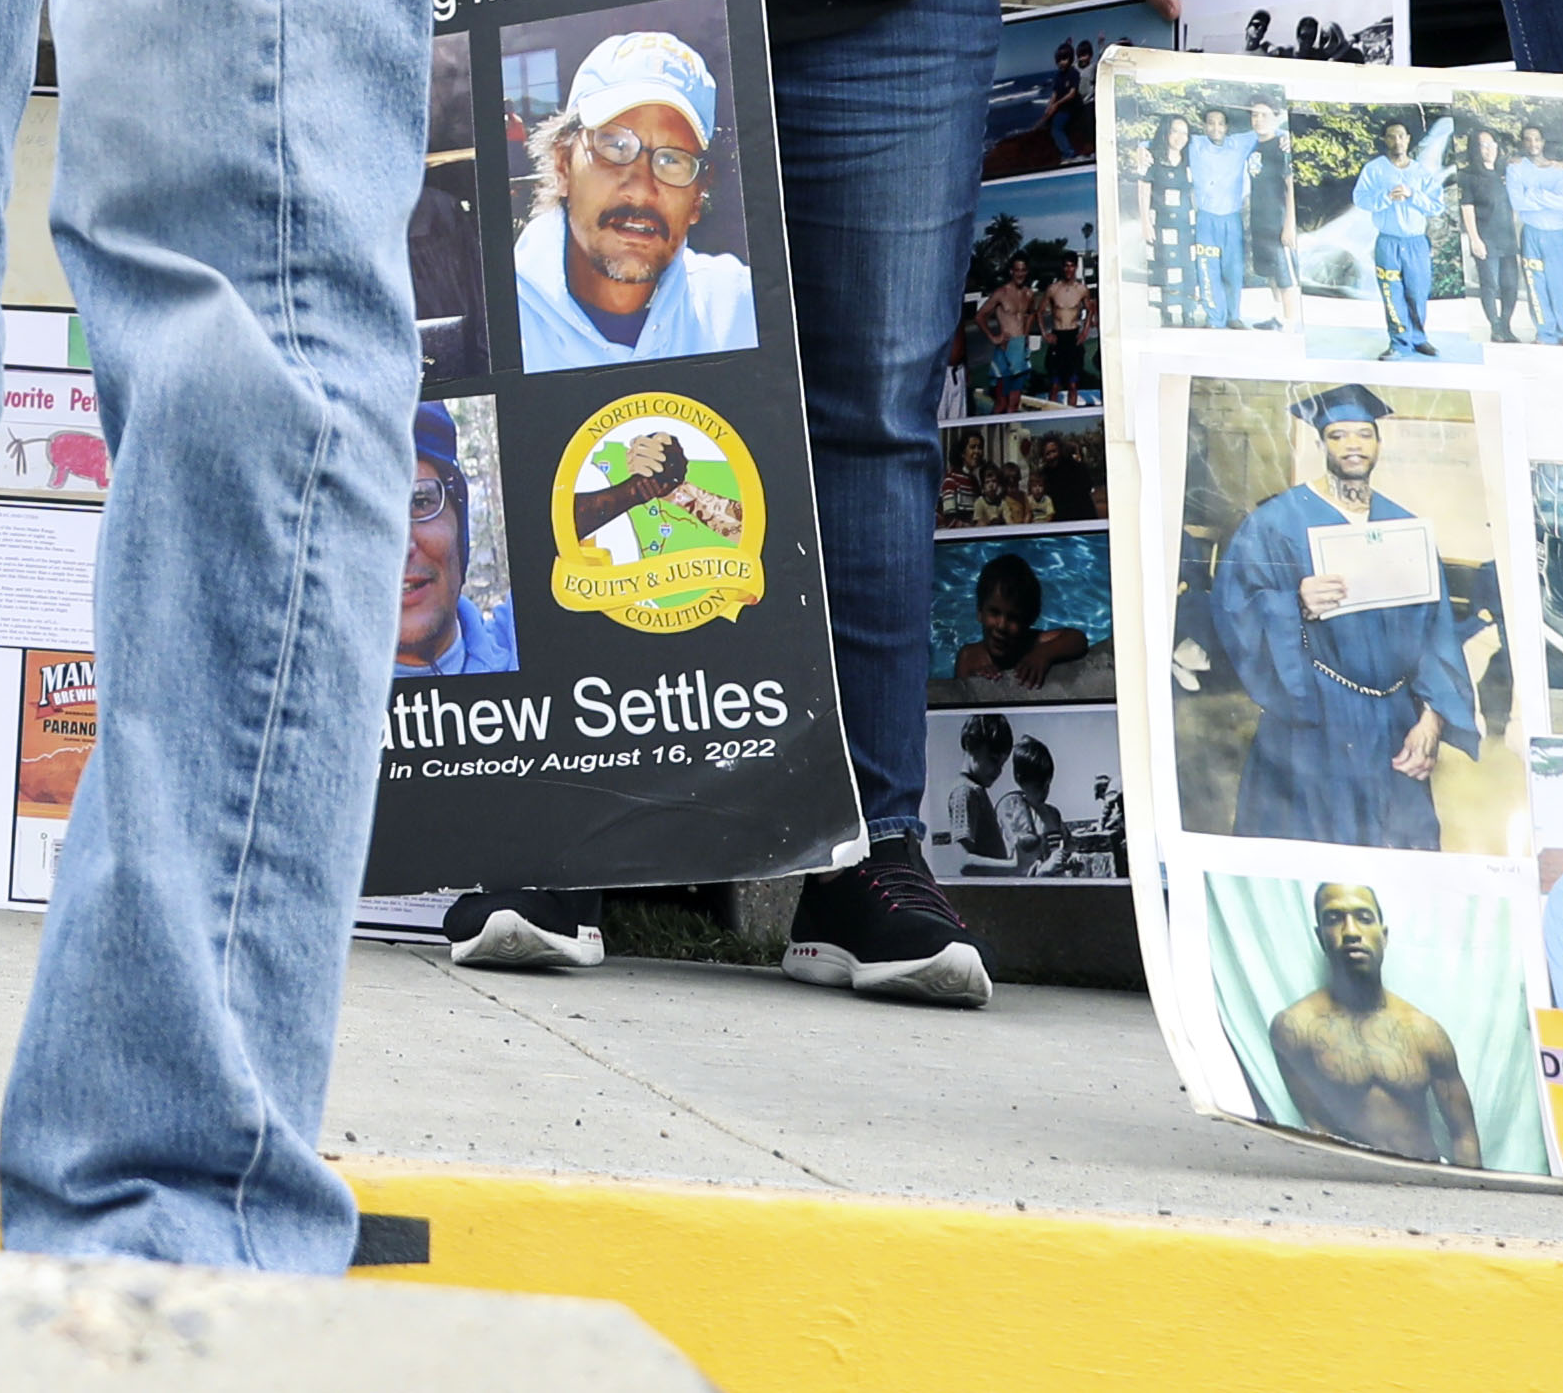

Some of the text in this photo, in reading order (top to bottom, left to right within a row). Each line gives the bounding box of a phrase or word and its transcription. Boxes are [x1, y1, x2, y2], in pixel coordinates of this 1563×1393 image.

[4, 387, 54, 410] vorite
[588, 398, 729, 442] NORTH COUNTY
[564, 558, 752, 600] EQUITY & JUSTICE
[625, 588, 728, 629] COALITION
[39, 660, 97, 706] MAM
[43, 719, 96, 737] PARANO
[378, 669, 789, 751] tthew Settles
[388, 760, 413, 780] in
[421, 753, 535, 780] Custody
[541, 747, 642, 774] August
[651, 744, 693, 765] 16,
[705, 738, 776, 759] 2022
